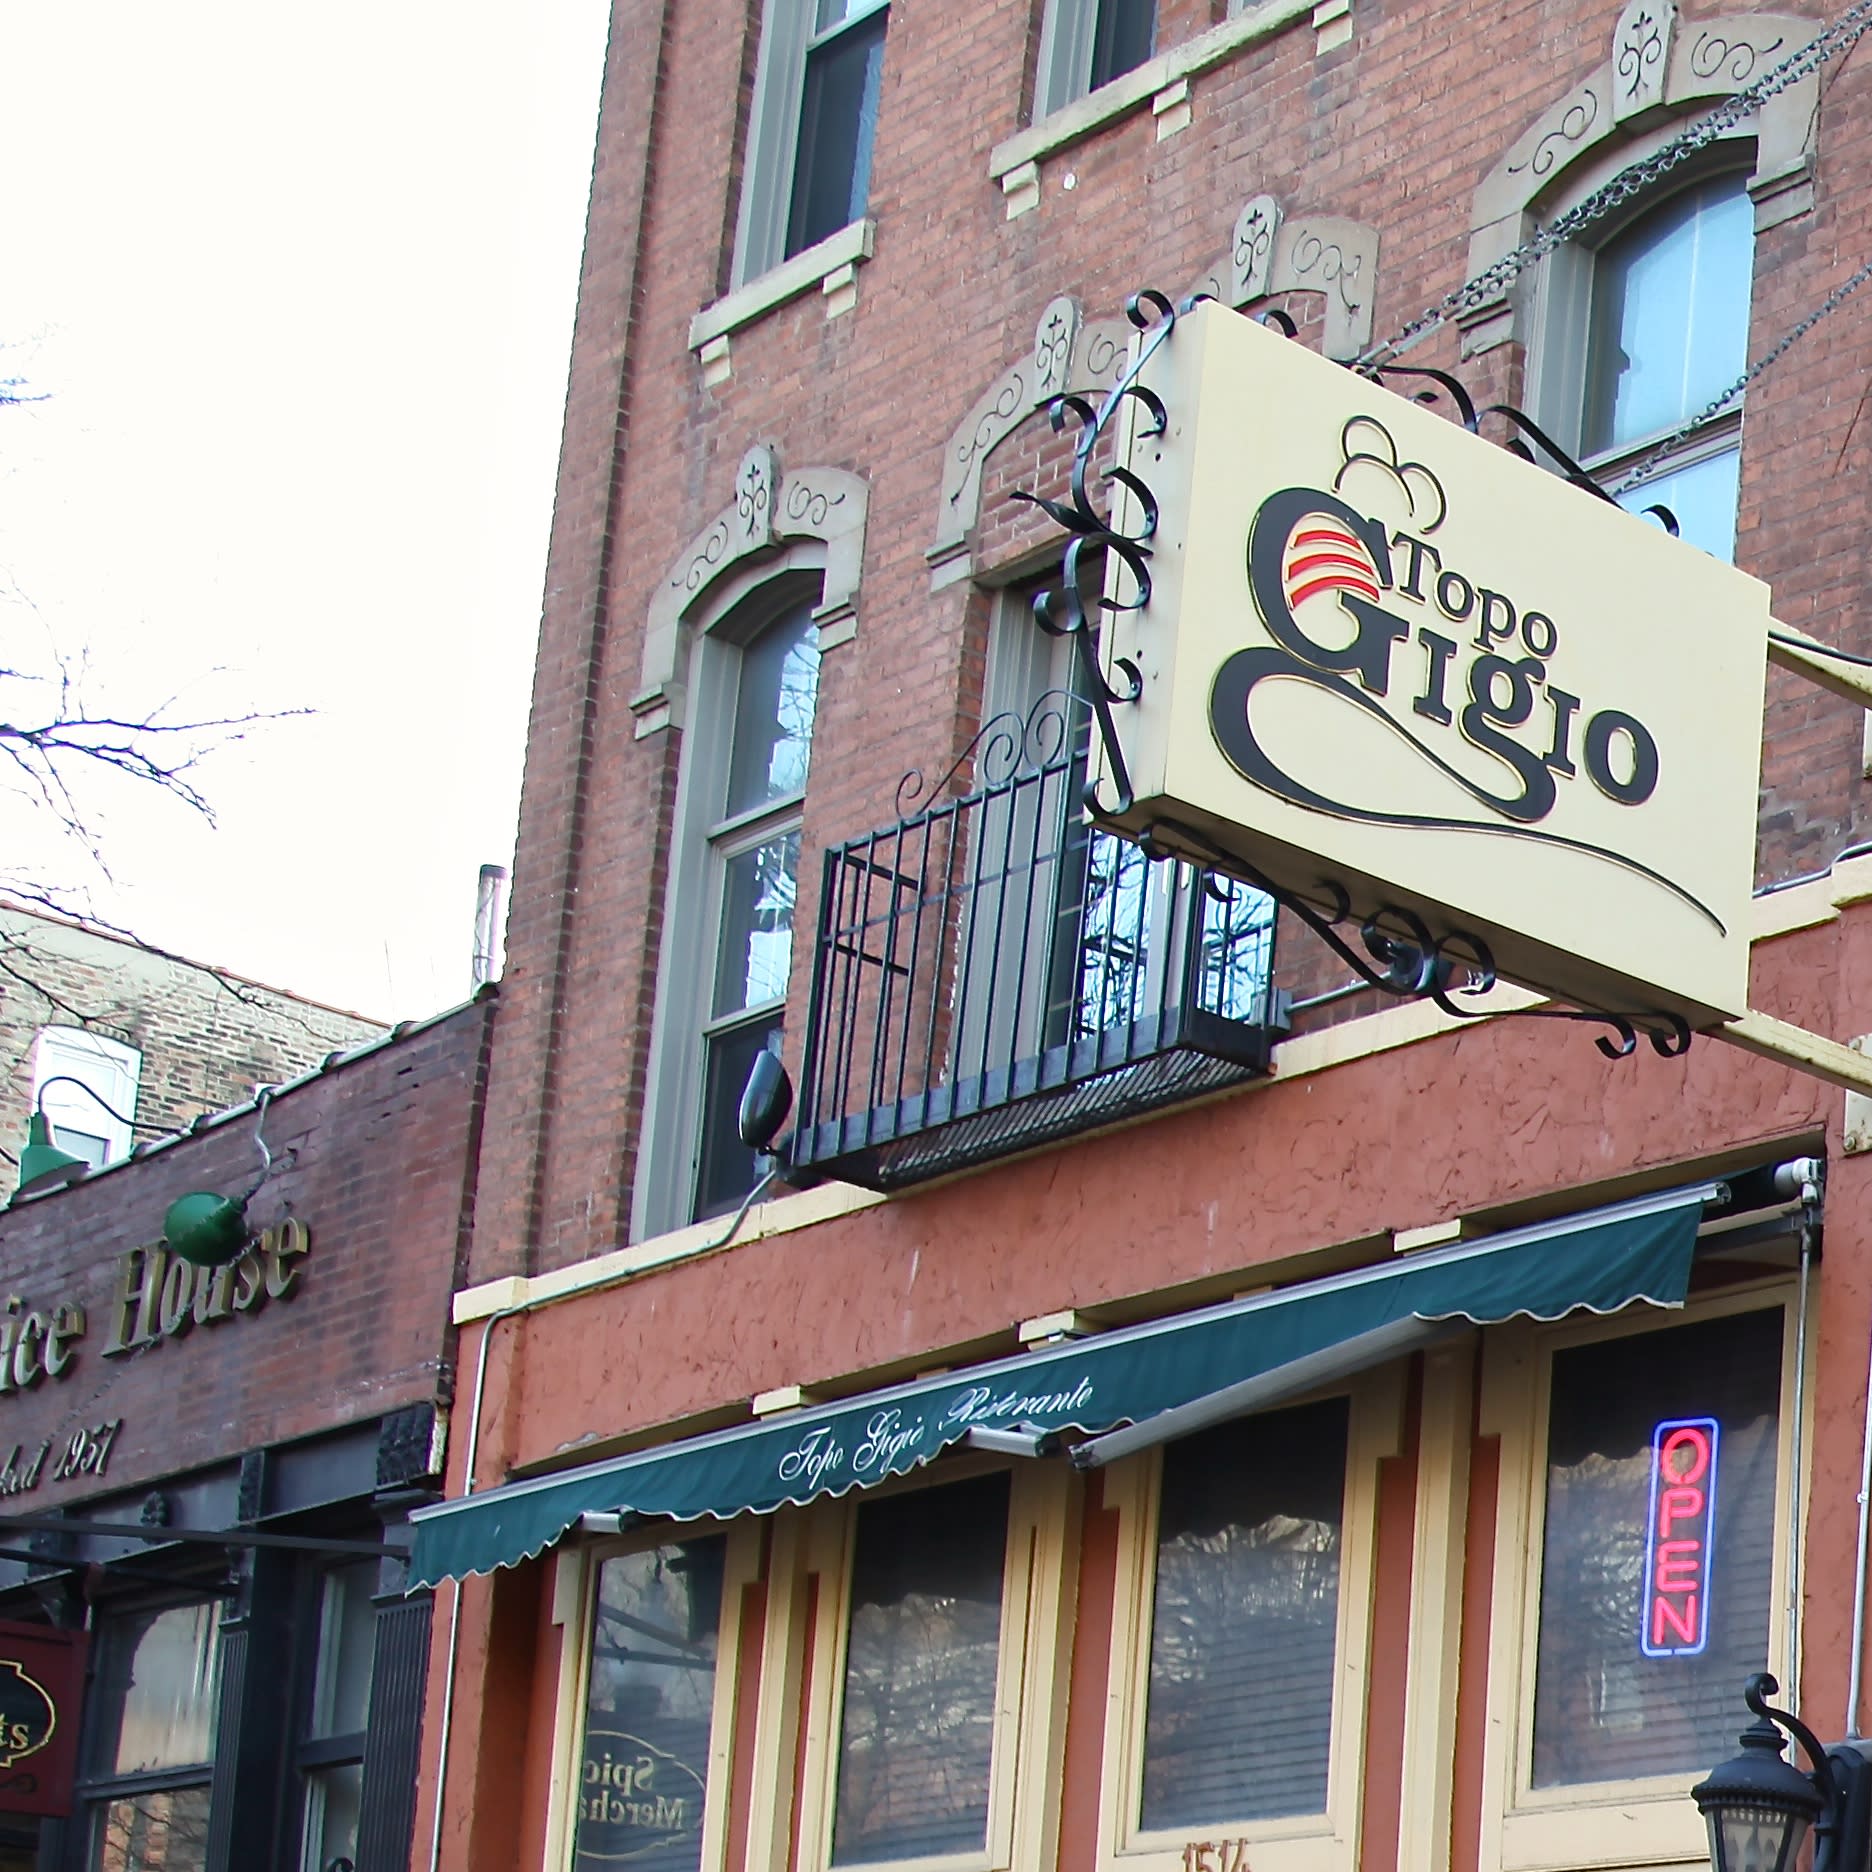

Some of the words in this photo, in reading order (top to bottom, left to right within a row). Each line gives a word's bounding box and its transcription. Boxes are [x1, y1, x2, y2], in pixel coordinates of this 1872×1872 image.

[1391, 531, 1558, 658] Topo
[101, 1217, 309, 1357] House
[54, 1419, 122, 1481] 1957
[779, 1426, 845, 1490] Topo
[852, 1408, 924, 1474] Gigio
[938, 1375, 1094, 1432] Ristorante
[1653, 1428, 1710, 1645] OPEN
